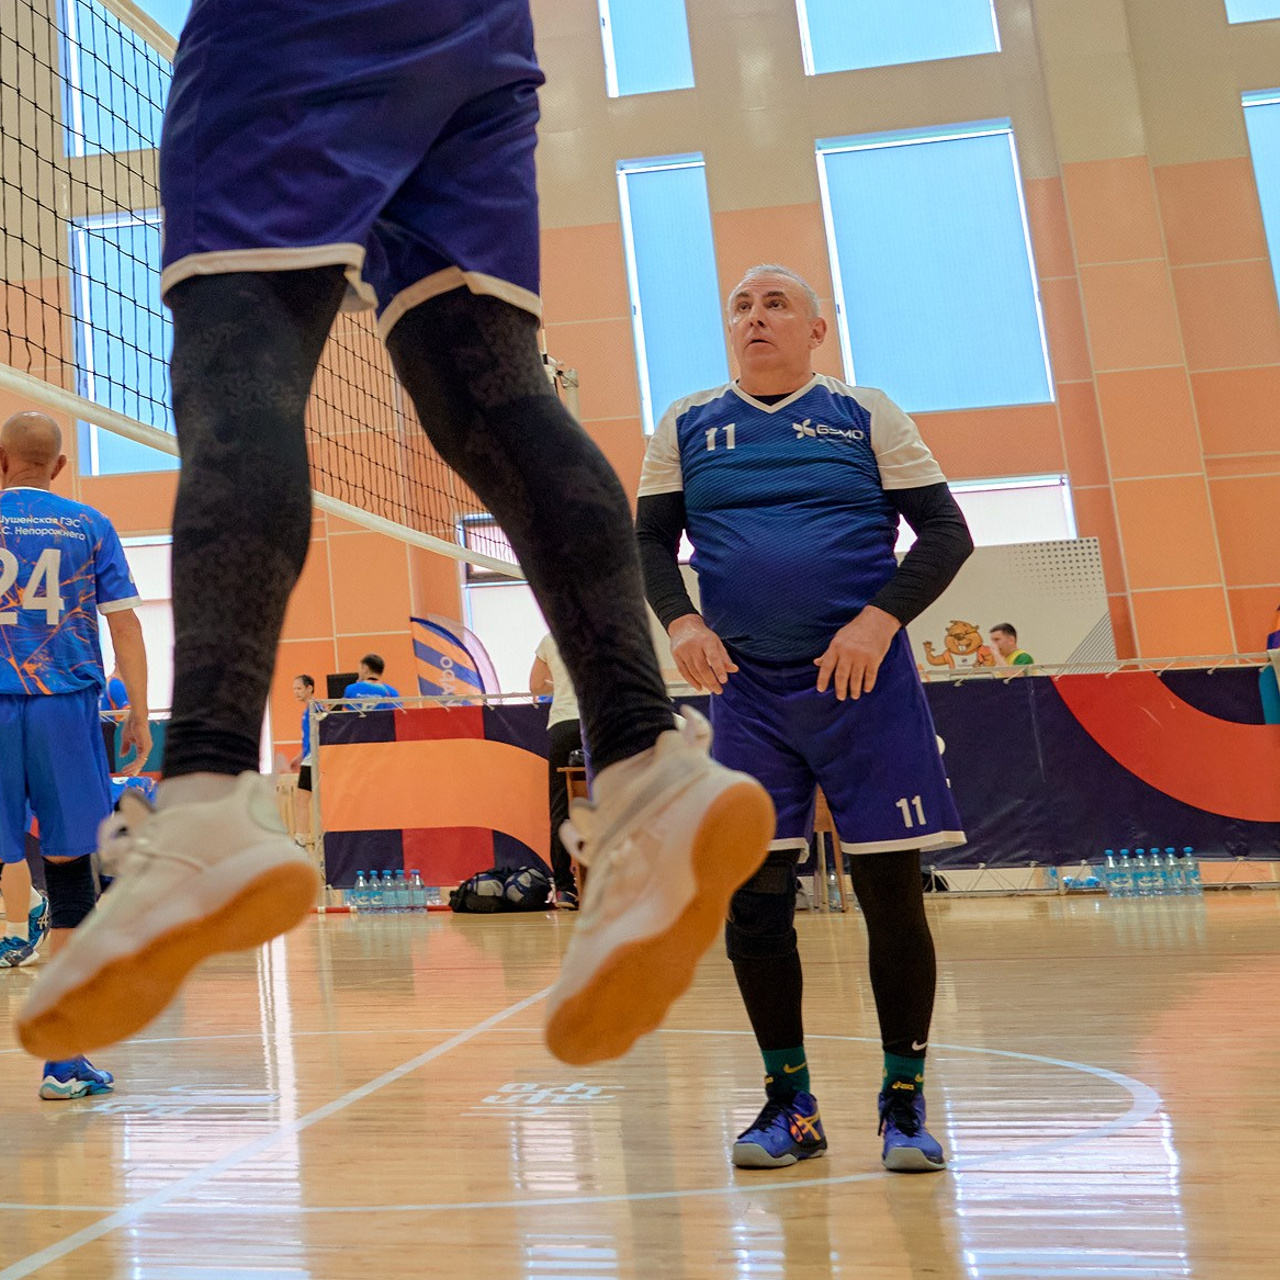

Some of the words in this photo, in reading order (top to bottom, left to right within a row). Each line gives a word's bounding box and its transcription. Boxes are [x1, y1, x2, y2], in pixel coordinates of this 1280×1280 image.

[704, 423, 736, 452] 11
[60, 516, 82, 528] ГЭС
[14, 526, 86, 541] Непорожнего
[895, 795, 927, 828] 11
